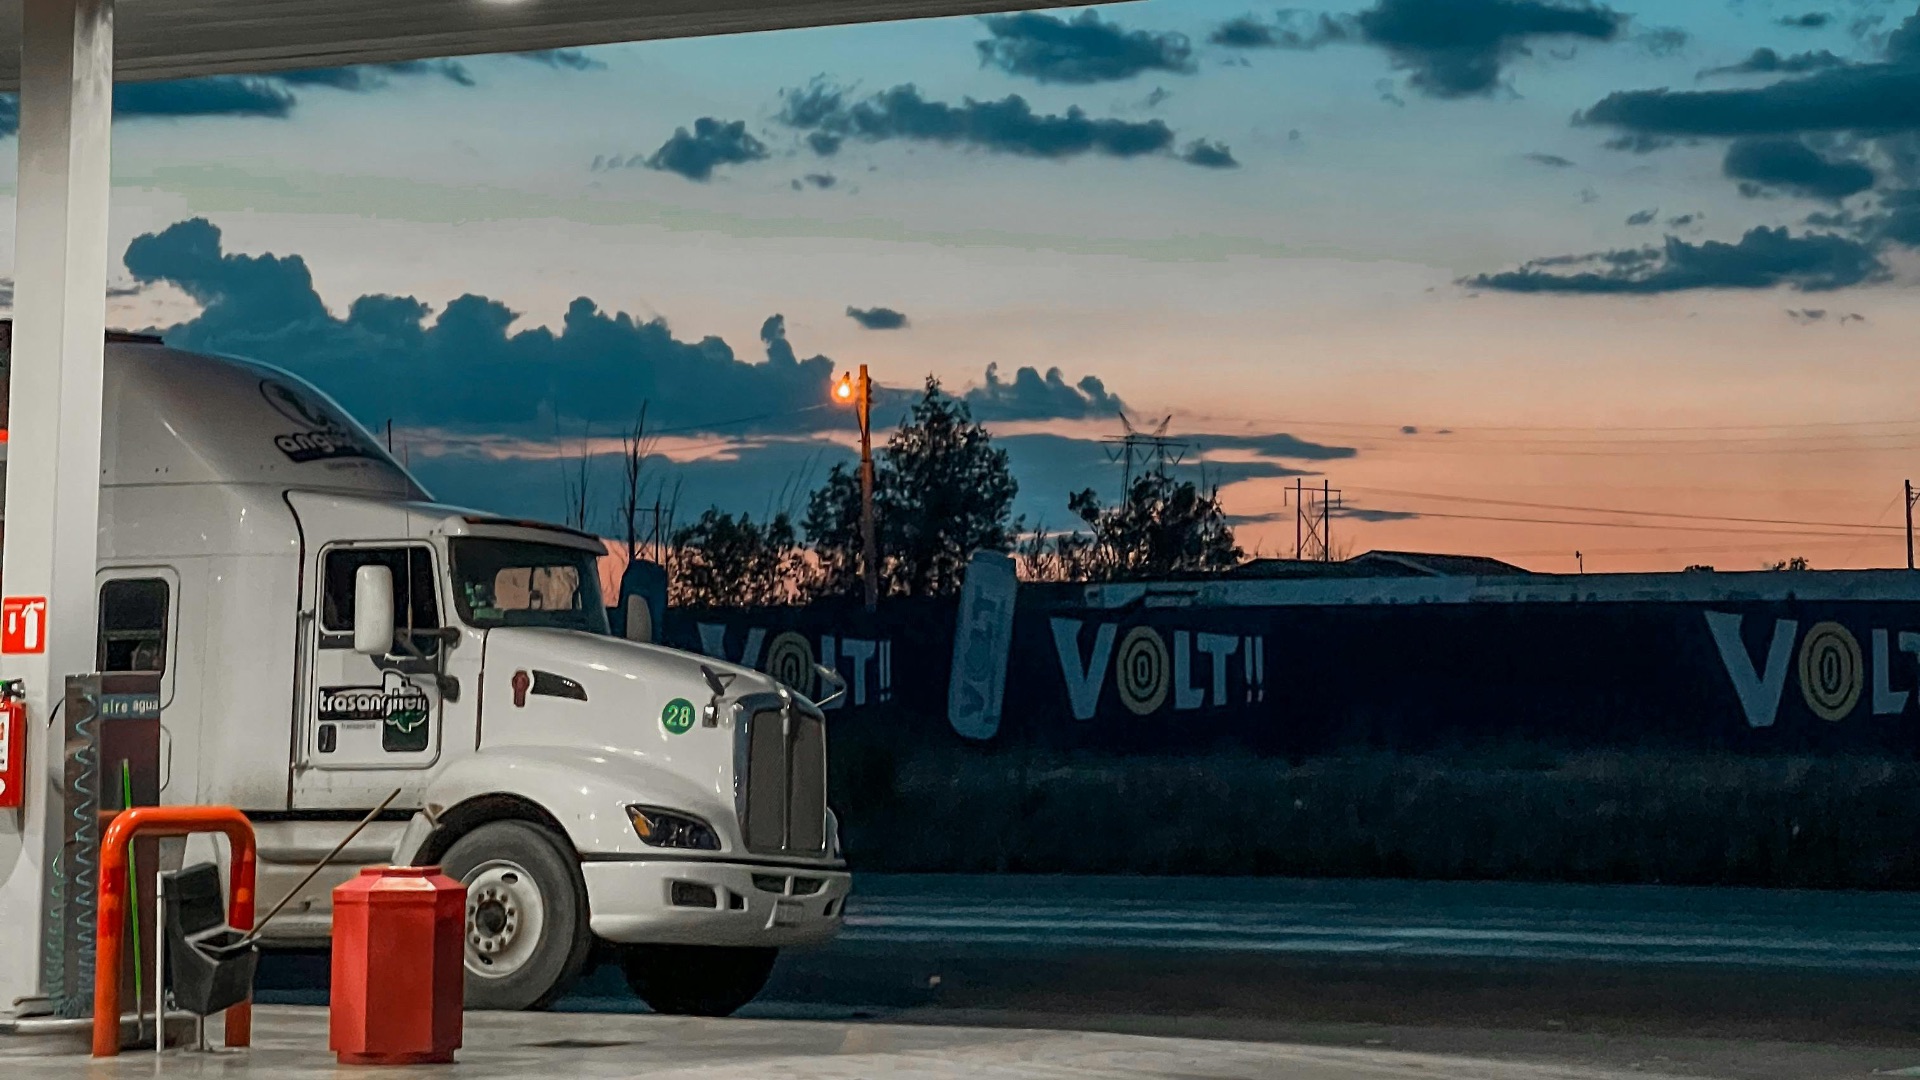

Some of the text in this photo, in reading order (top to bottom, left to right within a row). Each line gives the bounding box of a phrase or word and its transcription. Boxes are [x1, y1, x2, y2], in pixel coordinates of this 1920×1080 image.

[1049, 616, 1264, 721] VOLT!!
[102, 699, 159, 715] aire agua
[666, 704, 691, 727] 28
